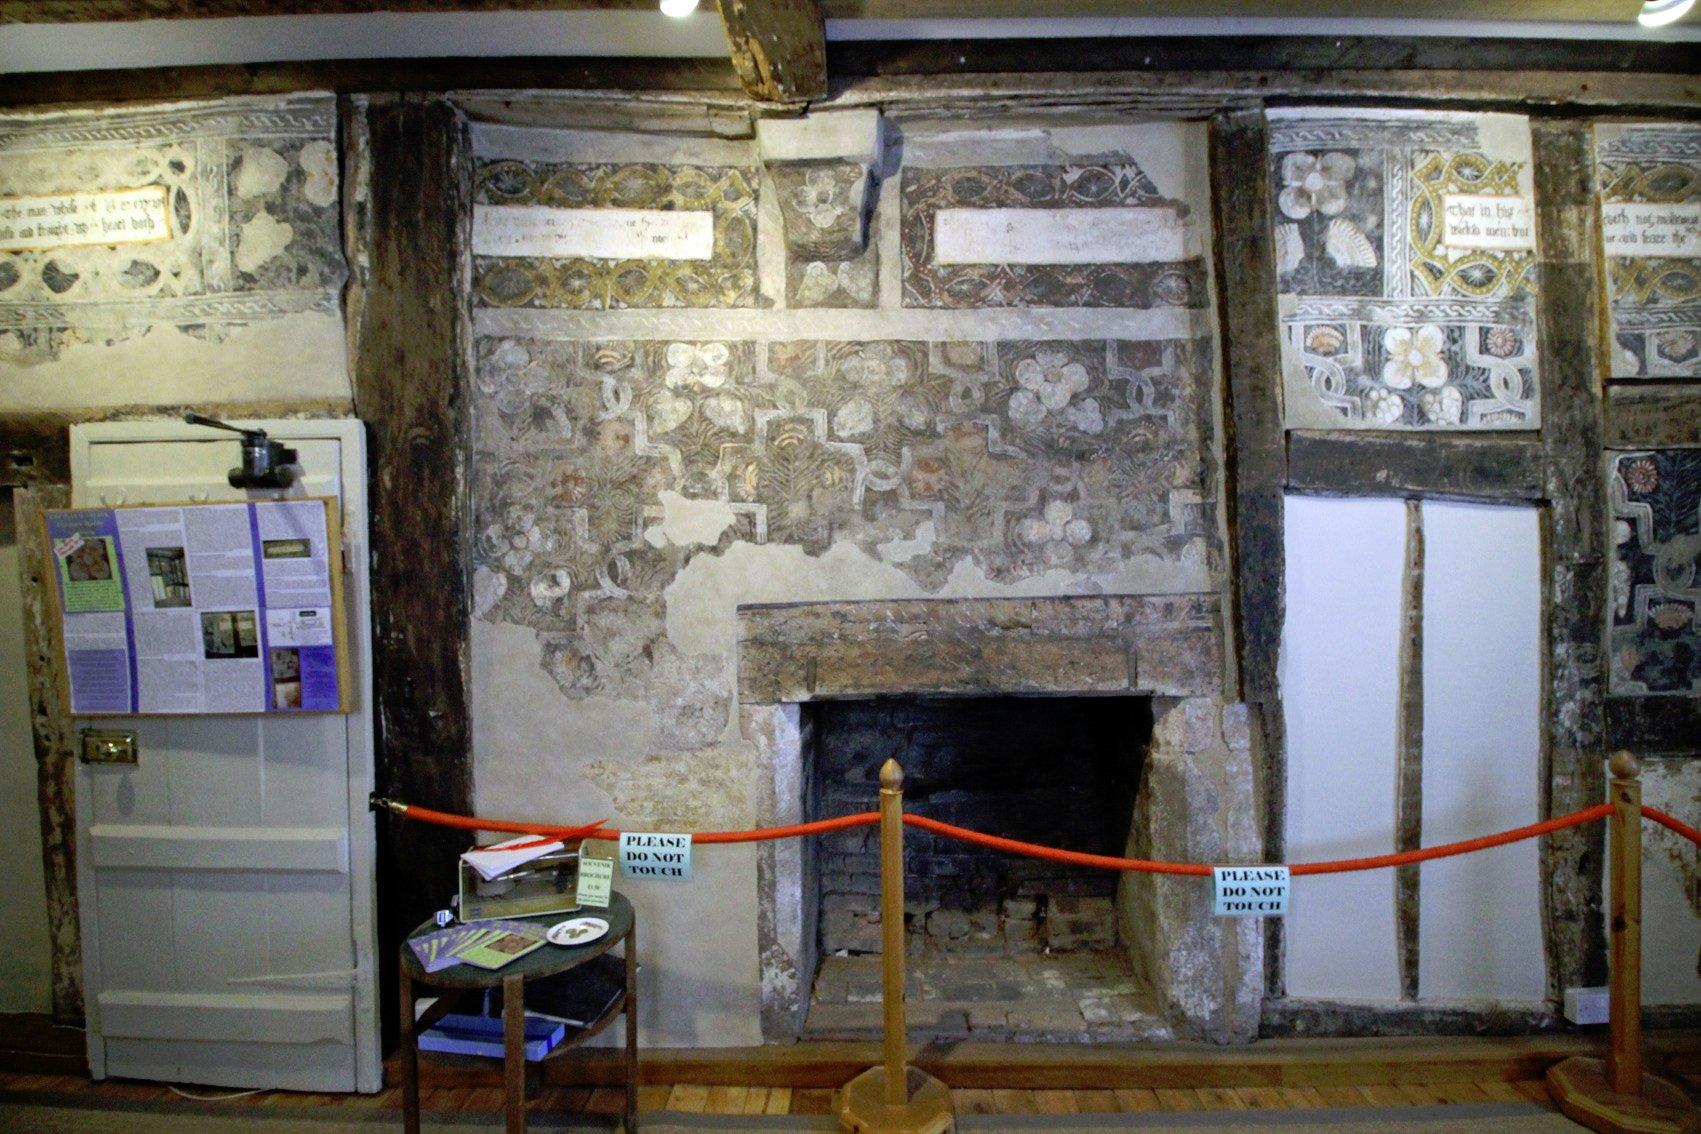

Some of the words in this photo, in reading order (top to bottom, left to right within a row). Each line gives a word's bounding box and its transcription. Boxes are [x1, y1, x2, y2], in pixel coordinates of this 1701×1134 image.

[627, 836, 686, 848] PLEASE
[627, 852, 648, 861] DO
[652, 853, 685, 863] NOT
[629, 866, 682, 876] TOUCH
[1222, 871, 1286, 881] PLEASE
[1223, 887, 1247, 897] DO
[1251, 887, 1286, 897] NOT
[1223, 902, 1281, 911] TOUCH
